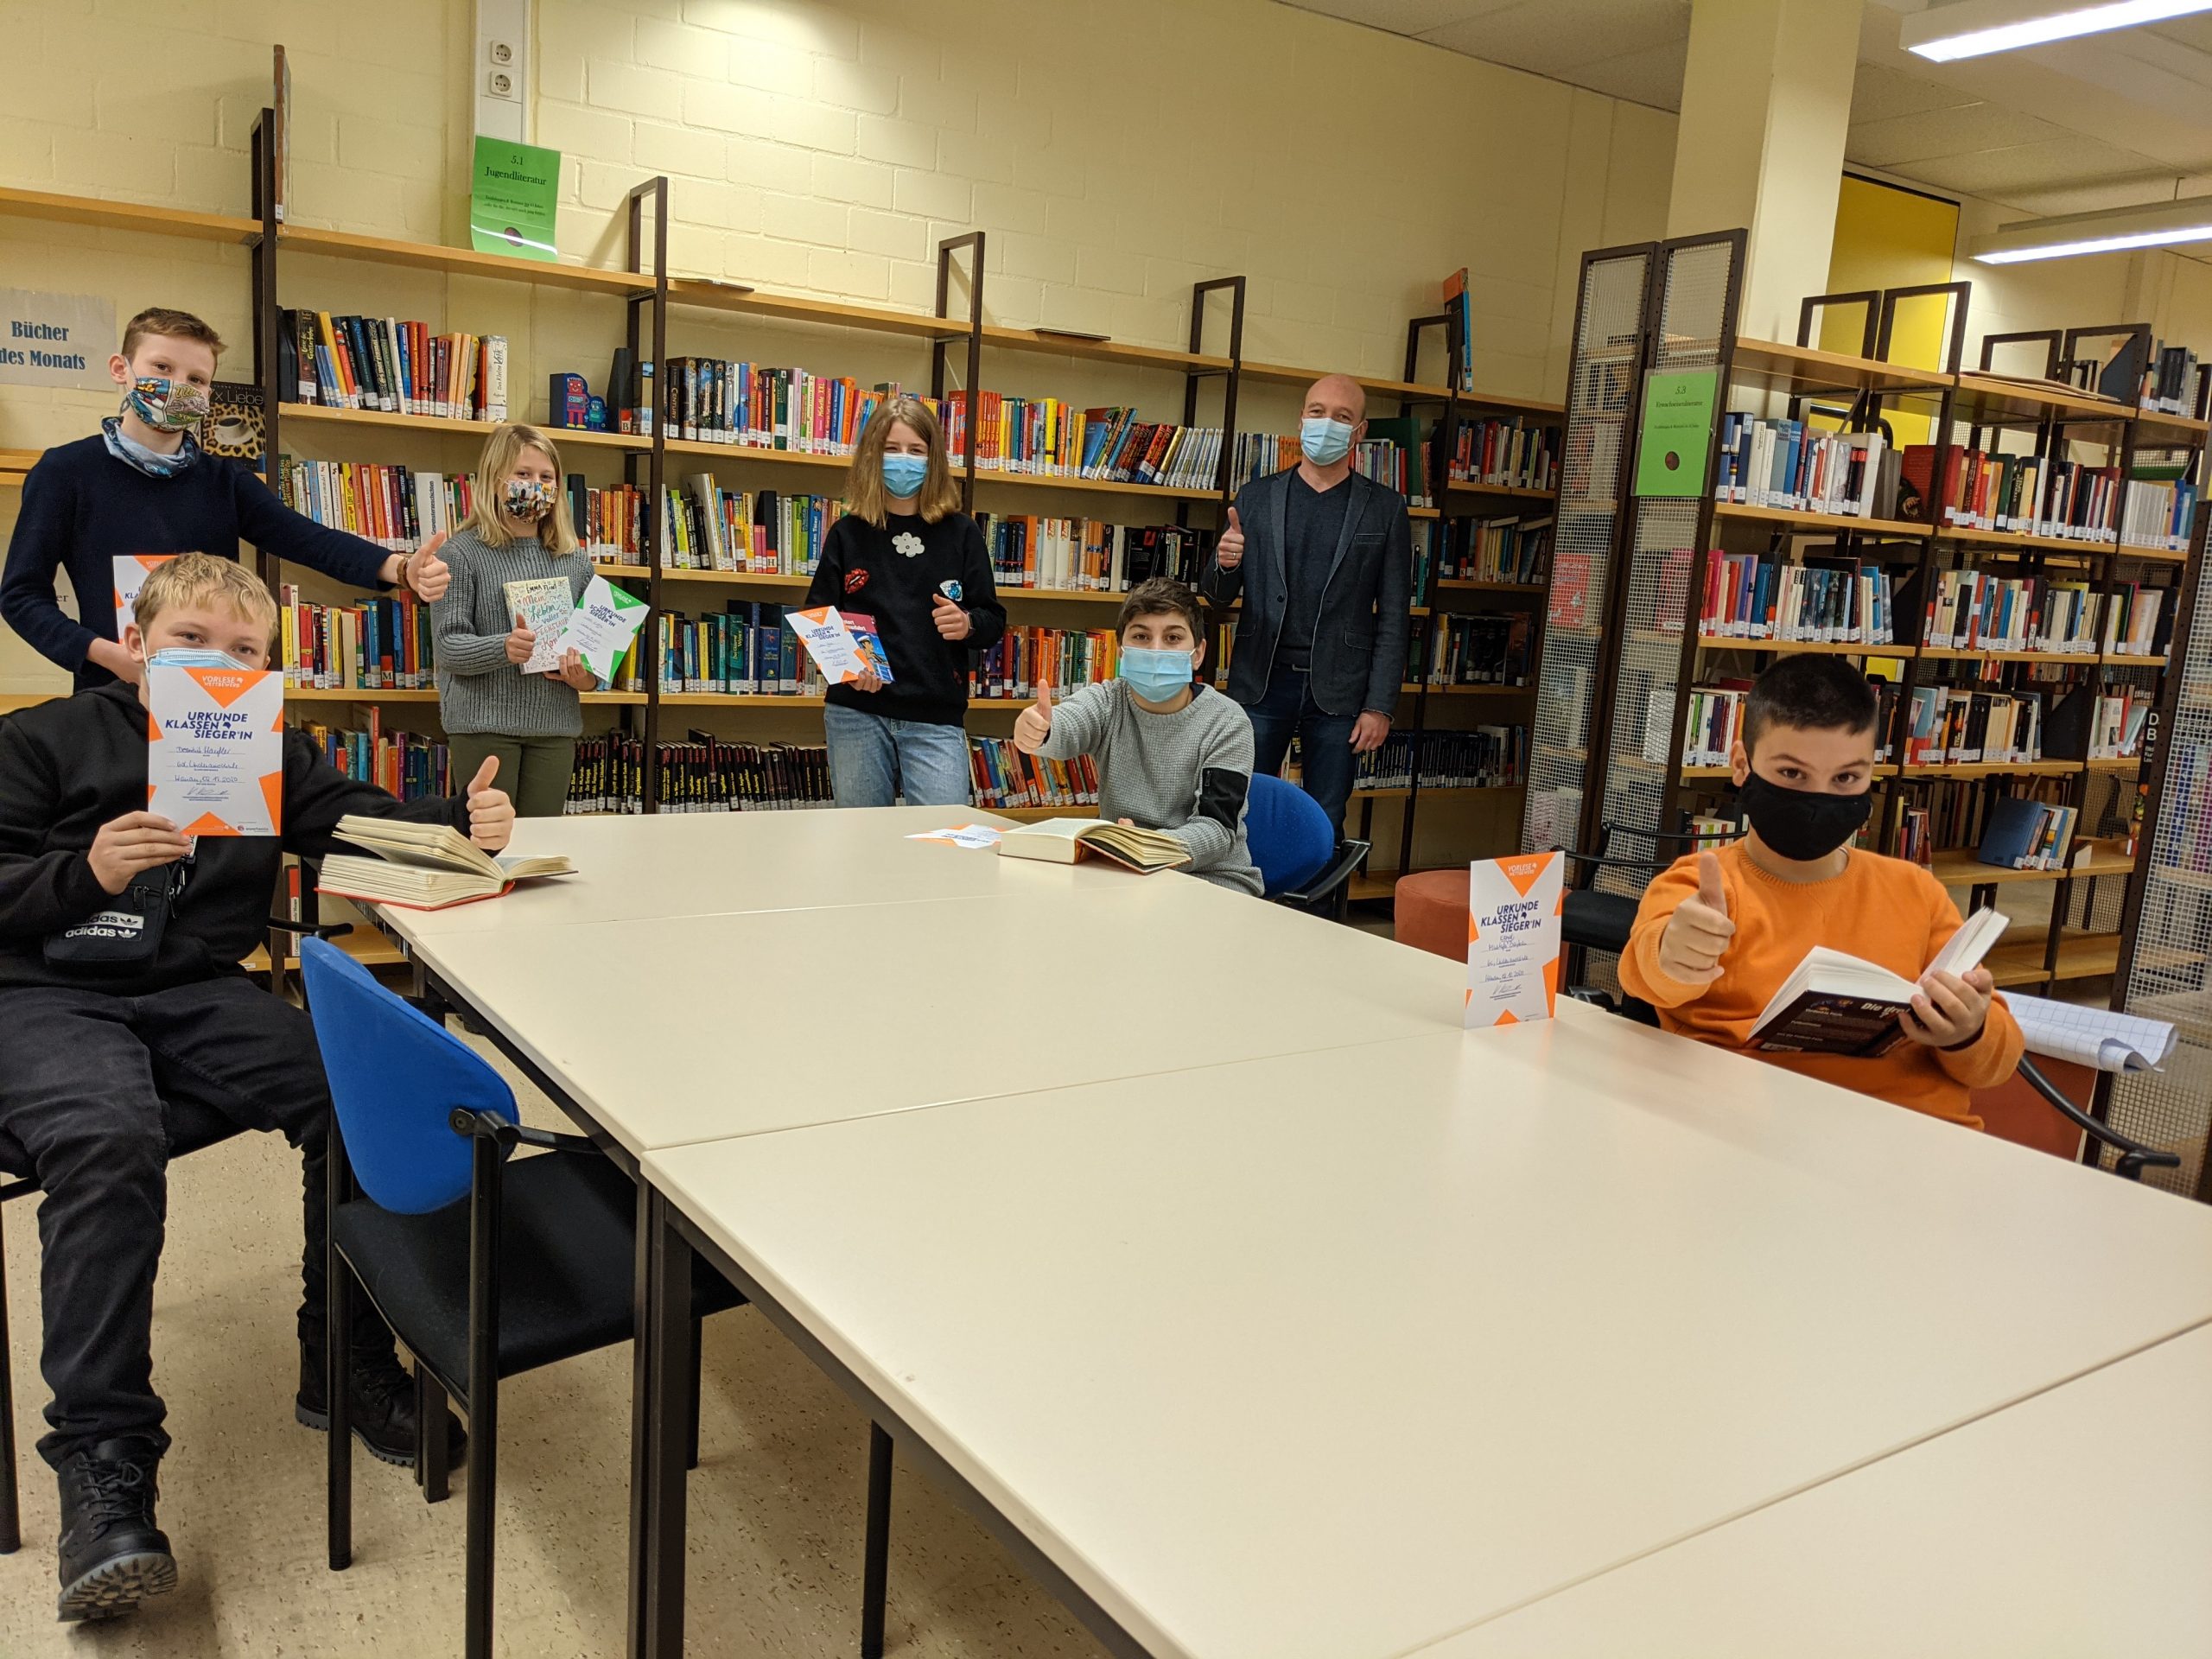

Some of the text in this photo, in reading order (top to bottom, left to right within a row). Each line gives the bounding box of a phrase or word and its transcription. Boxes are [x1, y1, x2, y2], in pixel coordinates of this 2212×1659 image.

[511, 156, 524, 165] 5.1
[485, 166, 547, 186] Jugendliteratur
[11, 321, 70, 341] Bücher
[0, 348, 86, 370] des Monats
[1675, 386, 1687, 395] 5.3
[227, 391, 264, 405] Liebe
[767, 556, 775, 566] H
[523, 594, 544, 607] Mein
[528, 602, 561, 622] Leben
[589, 603, 610, 620] SCHUL
[600, 604, 627, 624] URKUNDE
[382, 671, 392, 680] M
[188, 712, 248, 722] URKUNDE
[2148, 712, 2159, 726] D
[165, 719, 219, 730] KLASSEN
[2146, 728, 2158, 741] B
[1497, 900, 1539, 915] URKUNDE
[1481, 912, 1518, 927] KLASSEN
[65, 925, 117, 938] adidas
[1860, 1002, 1883, 1012] Die
